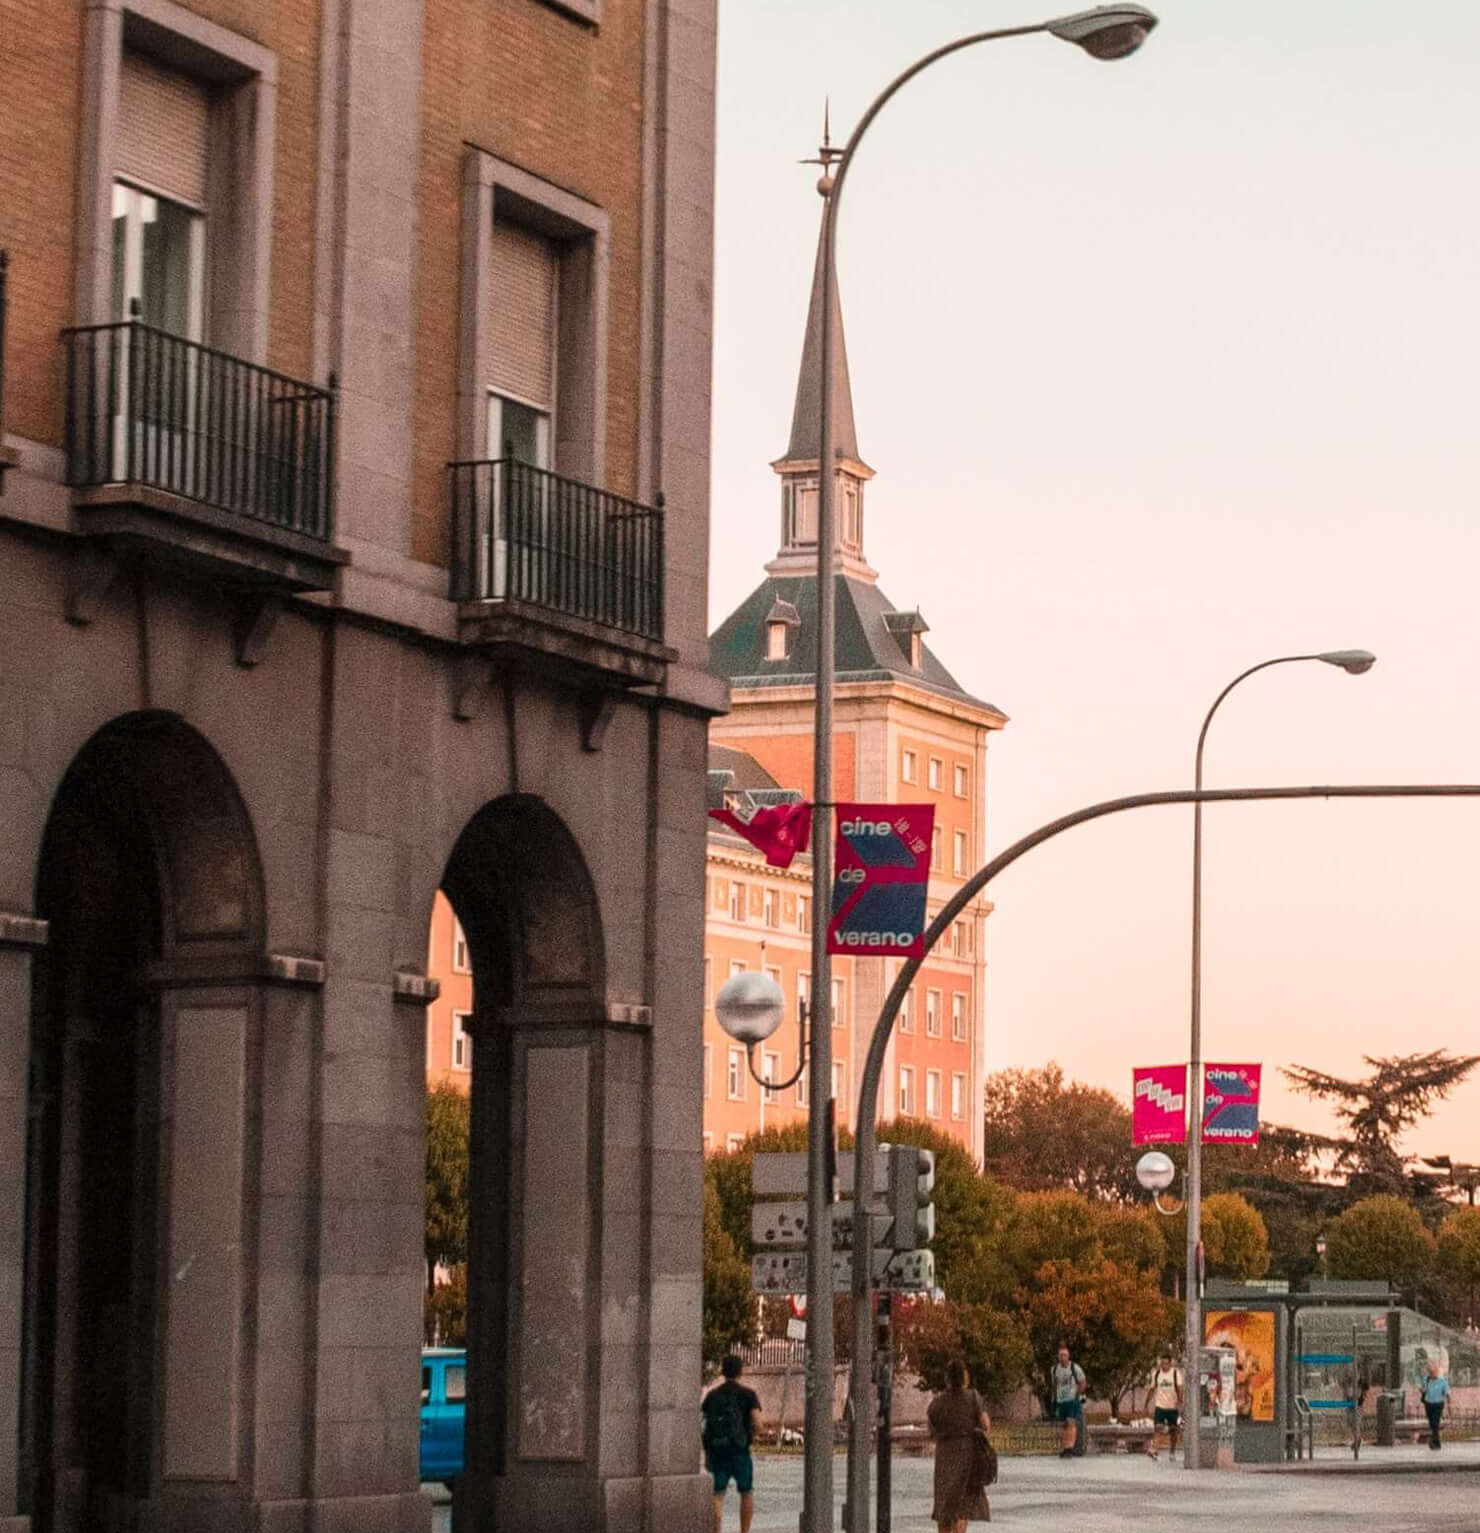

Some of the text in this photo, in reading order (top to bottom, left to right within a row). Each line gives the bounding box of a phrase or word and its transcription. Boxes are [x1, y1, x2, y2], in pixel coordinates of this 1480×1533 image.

[840, 816, 893, 837] cine
[839, 864, 867, 883] de
[834, 930, 915, 947] verano
